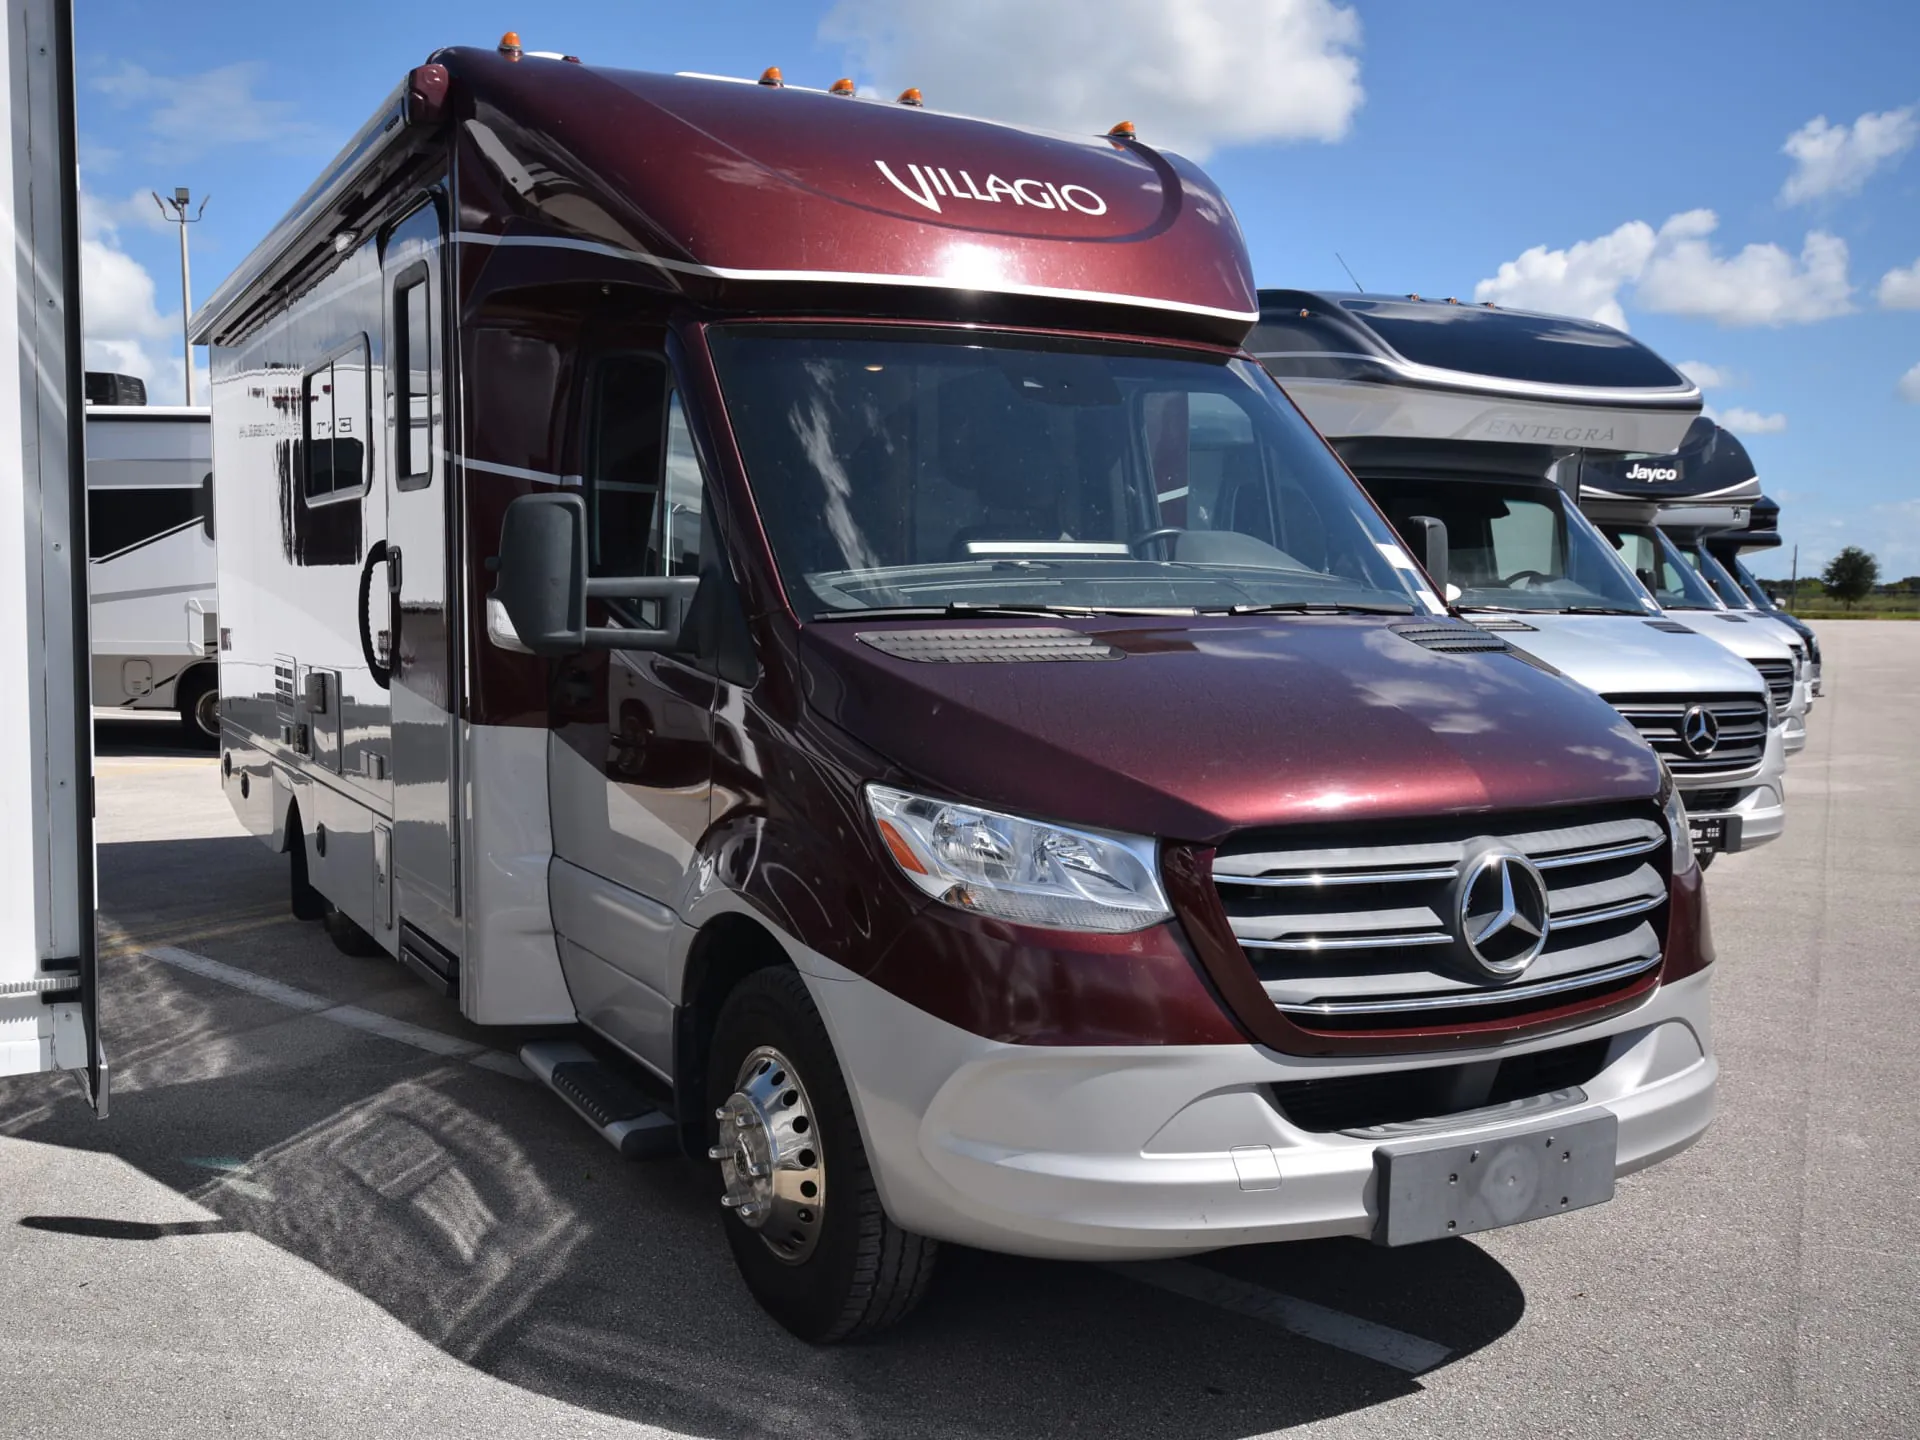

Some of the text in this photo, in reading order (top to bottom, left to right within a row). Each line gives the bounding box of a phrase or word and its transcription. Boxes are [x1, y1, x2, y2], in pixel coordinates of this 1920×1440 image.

[874, 159, 1107, 216] VILLAGIO
[1485, 420, 1615, 441] ENTEGRA
[1625, 463, 1678, 483] Jayco
